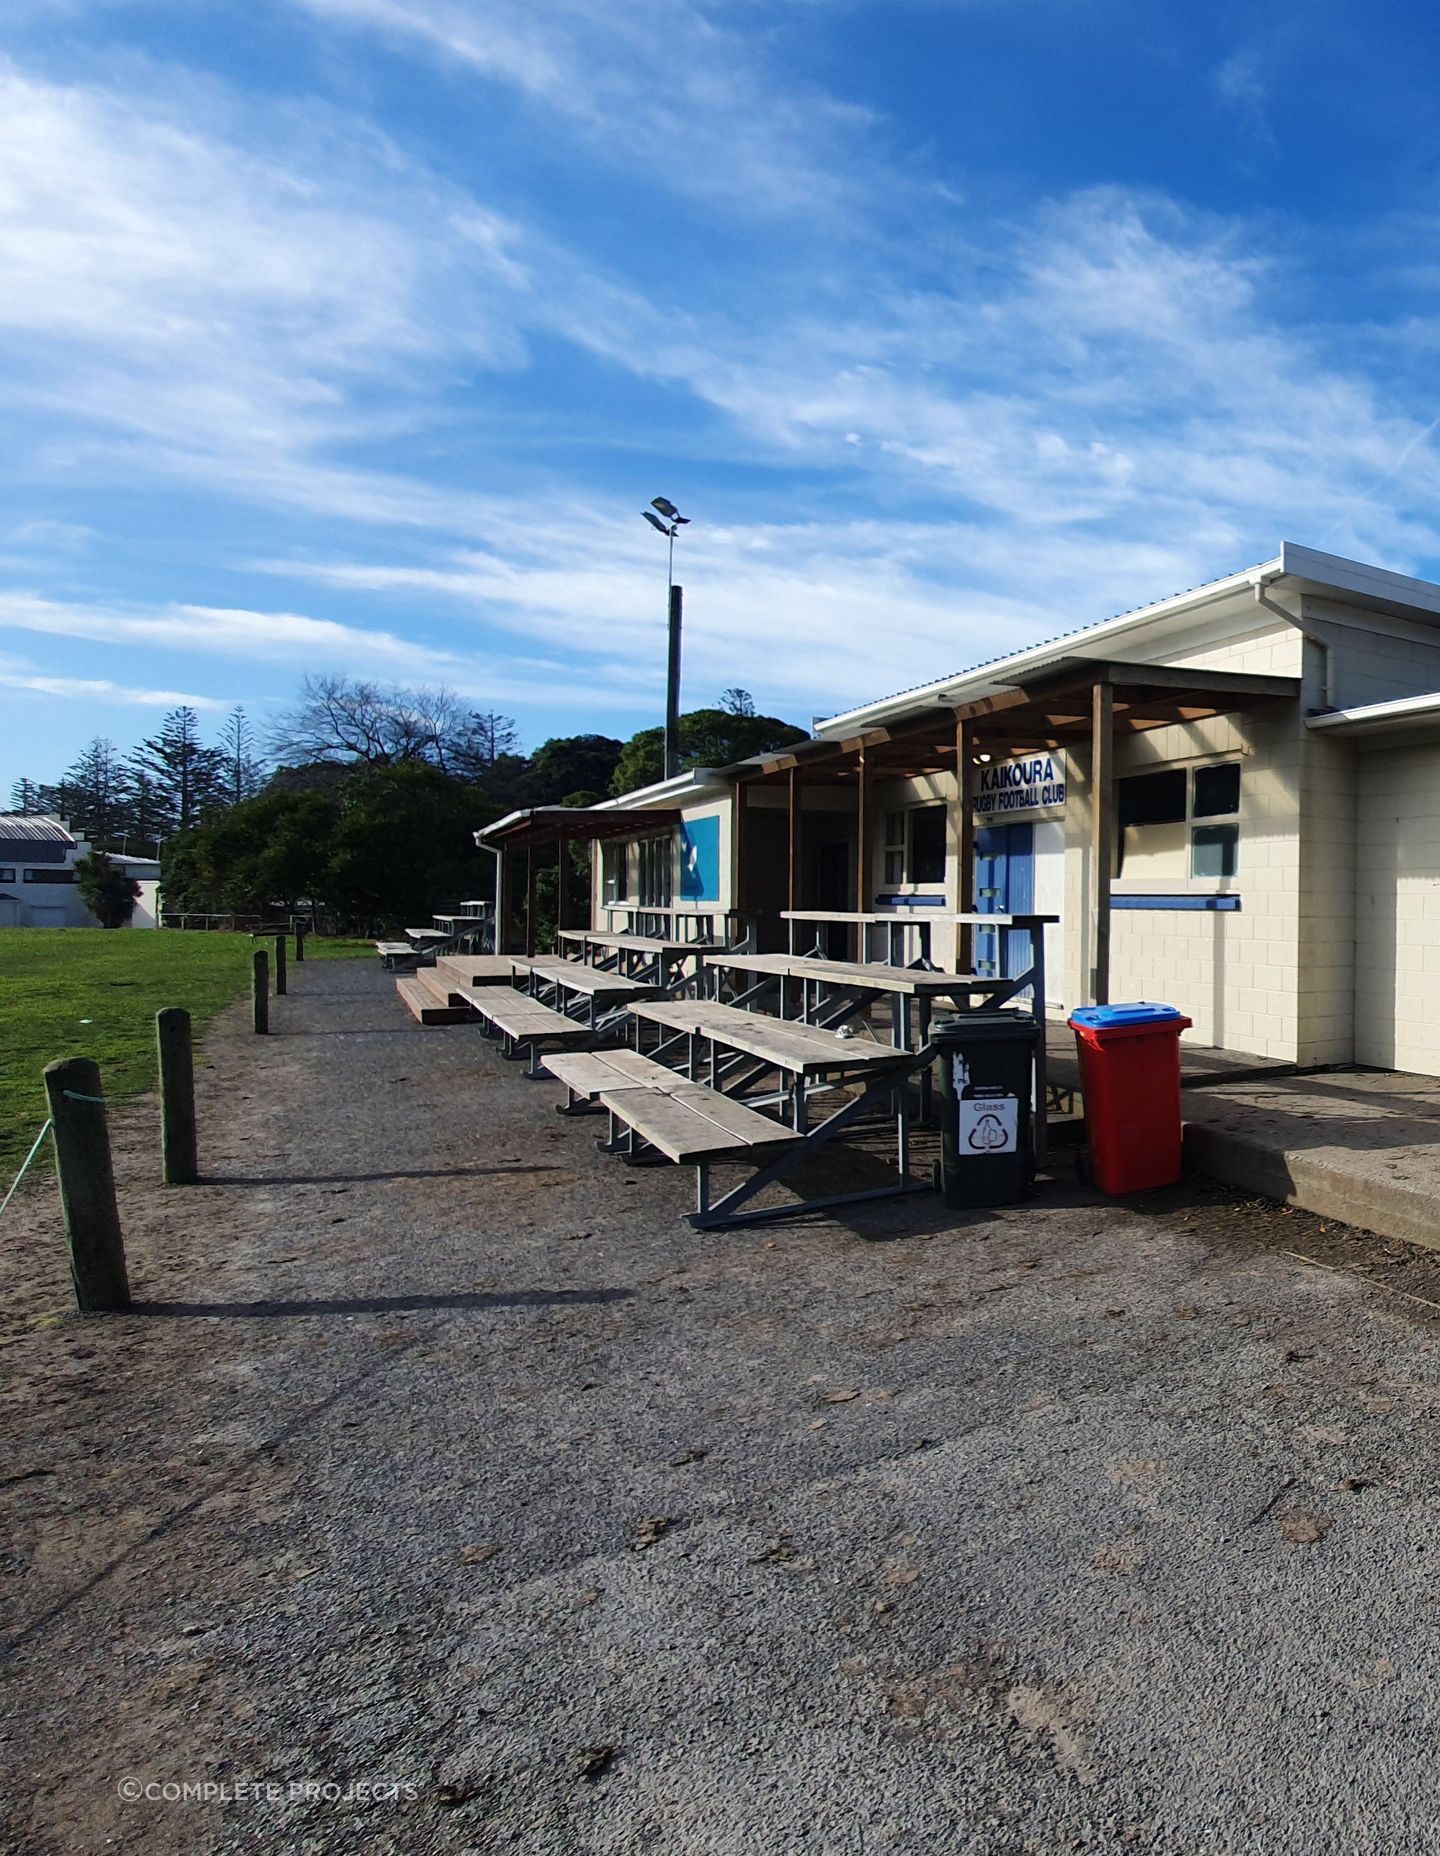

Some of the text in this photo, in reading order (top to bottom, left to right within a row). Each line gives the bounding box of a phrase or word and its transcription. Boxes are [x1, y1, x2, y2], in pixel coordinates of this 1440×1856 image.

[981, 758, 1053, 791] KAIKOURA
[998, 787, 1039, 810] FOOTBALL
[1042, 784, 1064, 804] CLUB
[974, 1102, 1005, 1112] Glass
